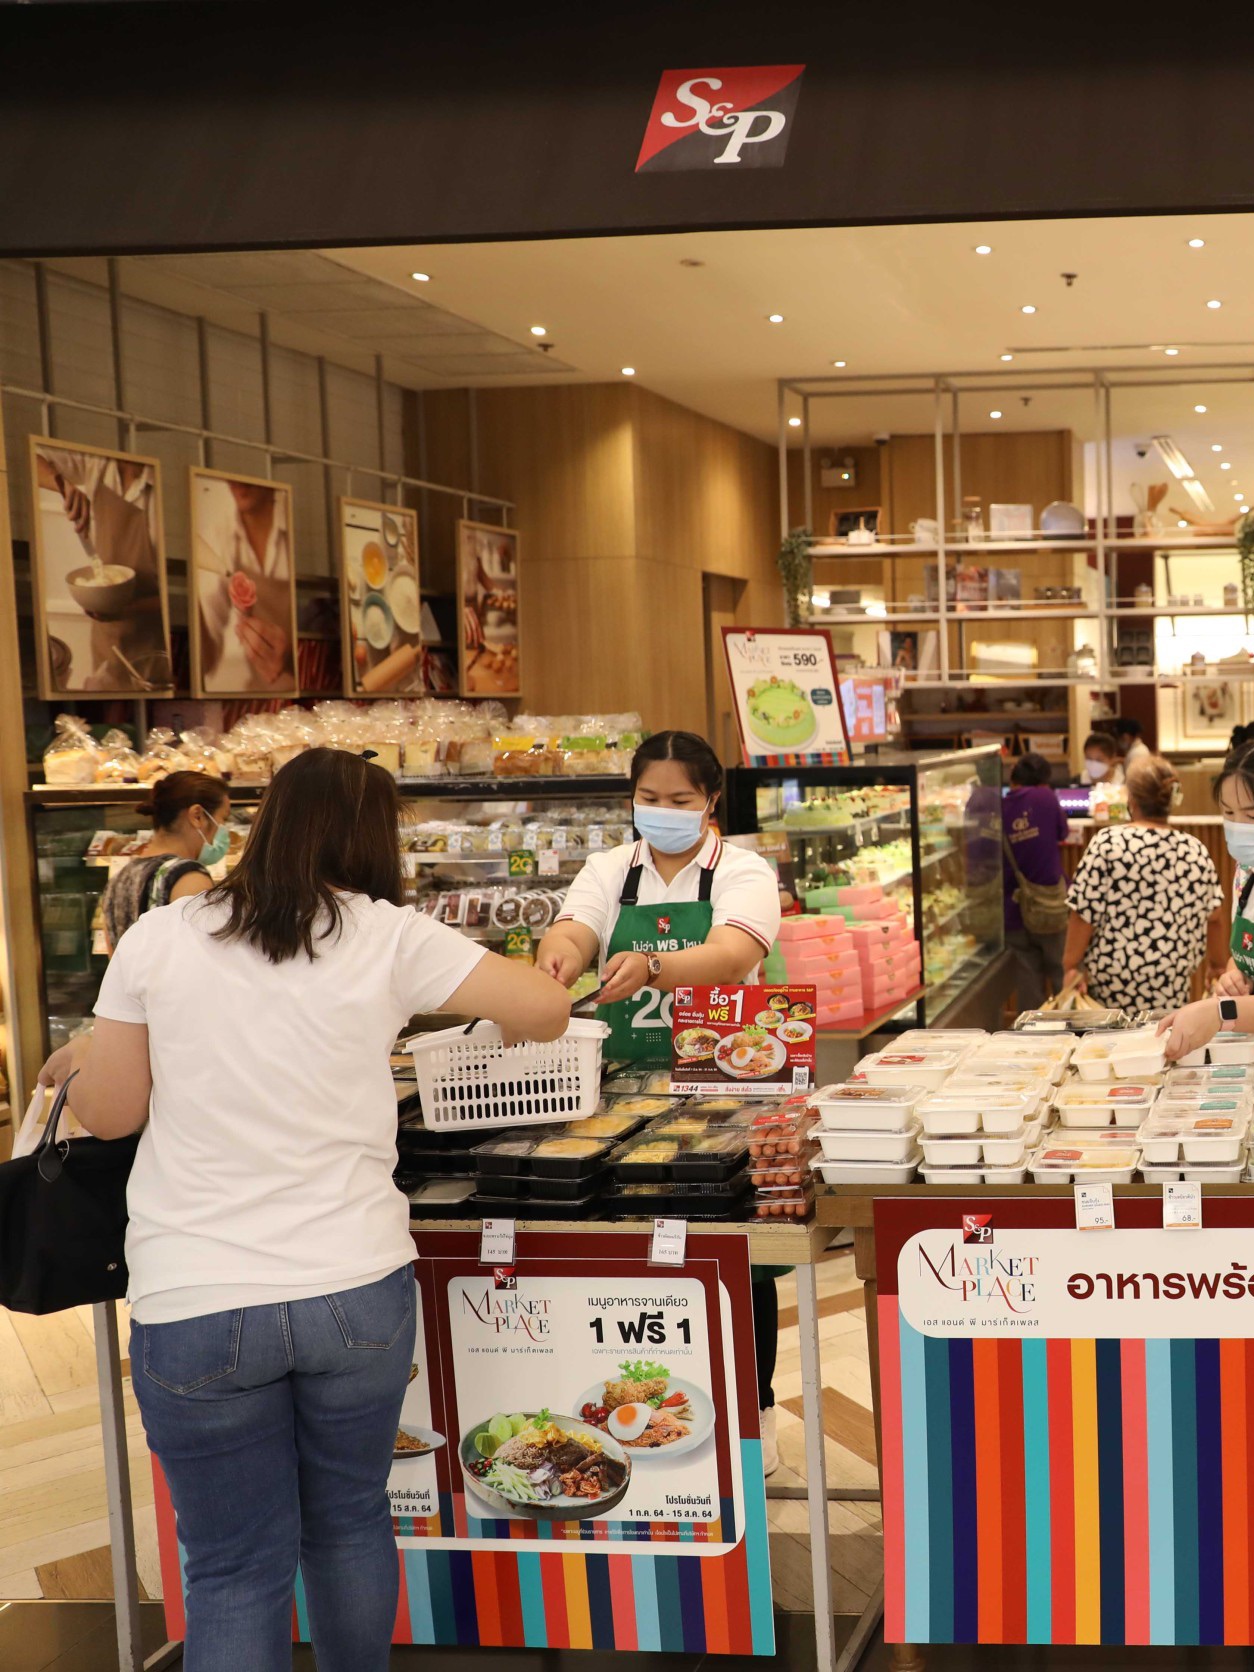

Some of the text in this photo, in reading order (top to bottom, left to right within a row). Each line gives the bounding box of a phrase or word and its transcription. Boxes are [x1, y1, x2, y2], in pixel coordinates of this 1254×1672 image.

[661, 77, 786, 164] S&P
[708, 1006, 730, 1021] ฟรี
[709, 987, 745, 1023] ซื้อ 1
[965, 1216, 992, 1242] S&P
[1182, 1214, 1196, 1222] 68.-
[495, 1268, 516, 1289] S&P
[918, 1242, 1039, 1290] MARKET
[462, 1288, 551, 1324] MARKET
[588, 1295, 688, 1310] เมนูอาหารจานเดียว
[960, 1276, 1036, 1314] PLACE
[495, 1314, 550, 1342] PLACE
[589, 1311, 691, 1344] 1 ฟรี 1
[393, 1504, 402, 1512] 15
[665, 1494, 712, 1505] โปรโมชั่นวันที่
[629, 1509, 633, 1517] 1
[636, 1509, 652, 1517] ก.ค.
[653, 1509, 664, 1517] 64
[672, 1510, 682, 1518] 15
[684, 1510, 700, 1518] ส.ค.
[702, 1510, 712, 1518] 64
